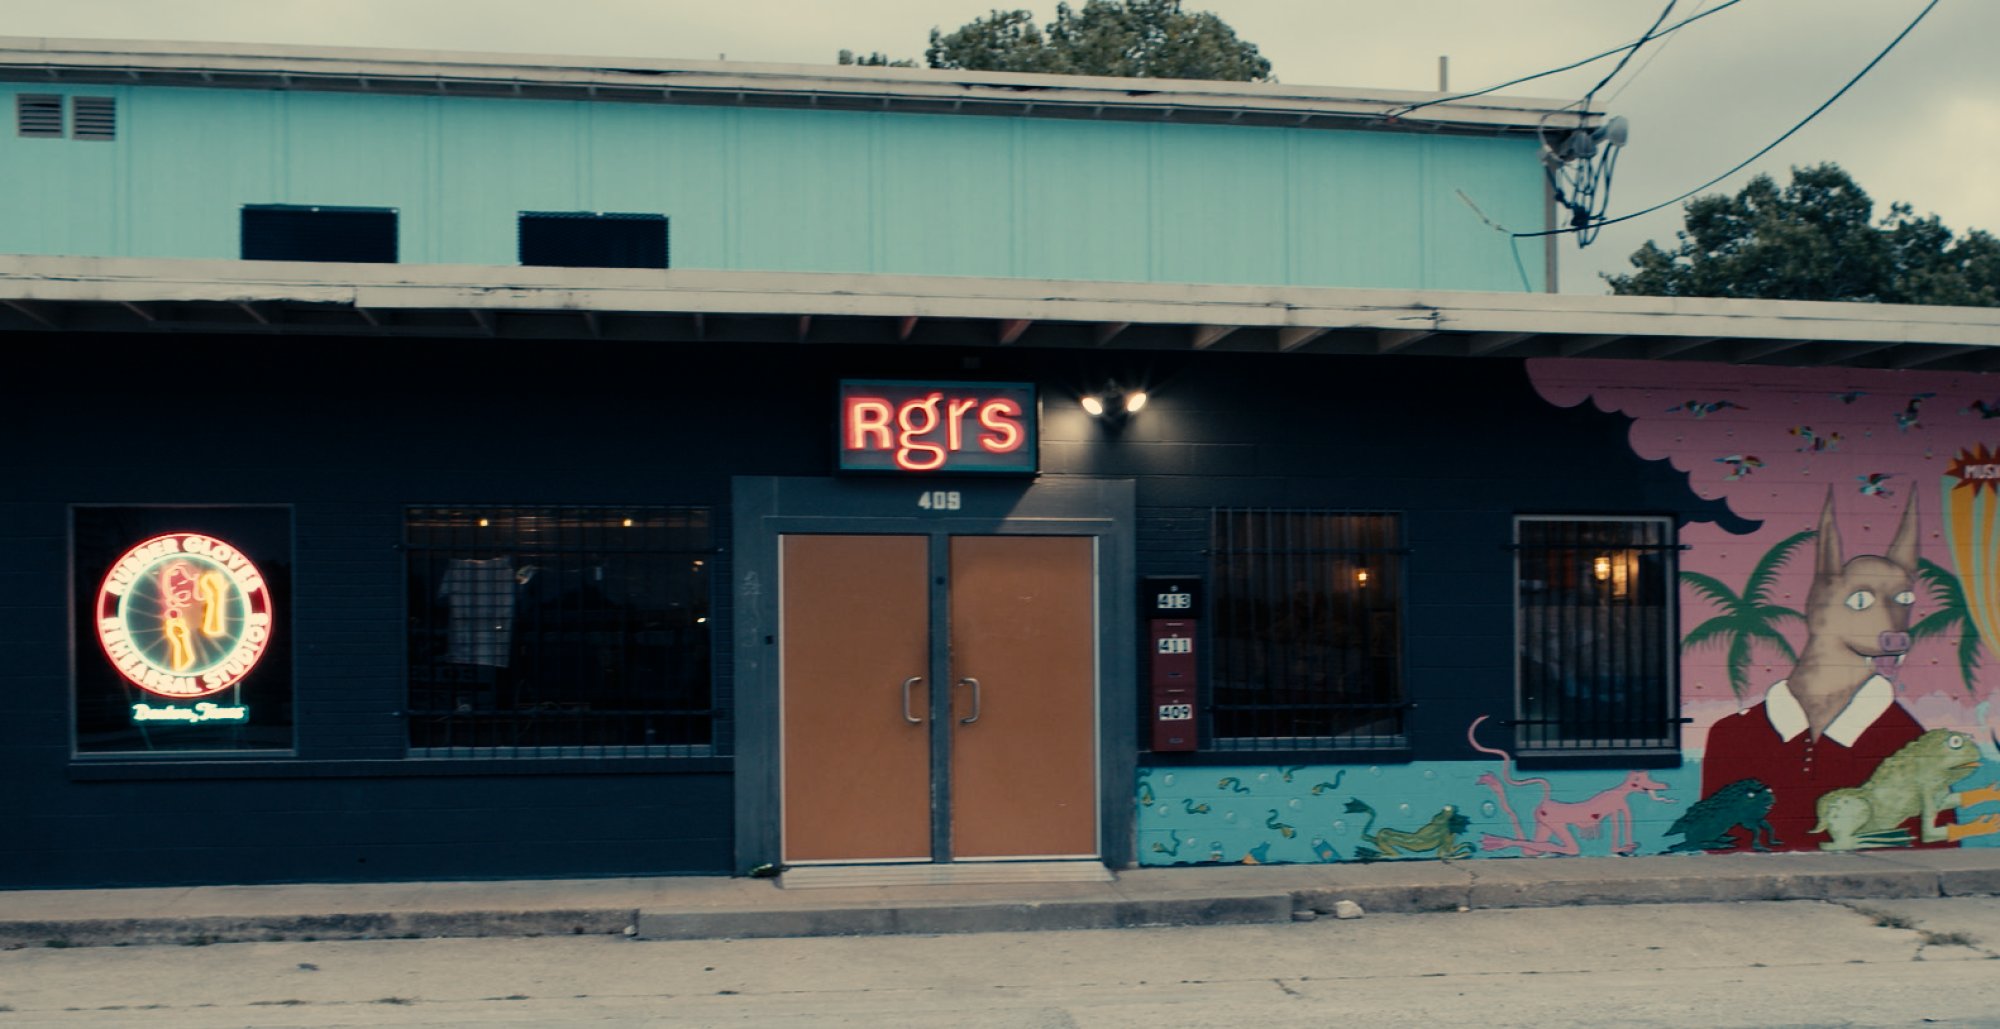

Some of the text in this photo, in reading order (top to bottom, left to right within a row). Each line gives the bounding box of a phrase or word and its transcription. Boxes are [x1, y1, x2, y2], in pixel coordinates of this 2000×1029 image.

[845, 392, 1024, 471] Rgrs
[918, 491, 961, 510] 409
[105, 536, 263, 595] RUBBER GLOVES
[1158, 594, 1190, 608] 413
[203, 613, 268, 689] STUDIOS
[1159, 639, 1190, 653] 411
[1160, 706, 1191, 720] 409
